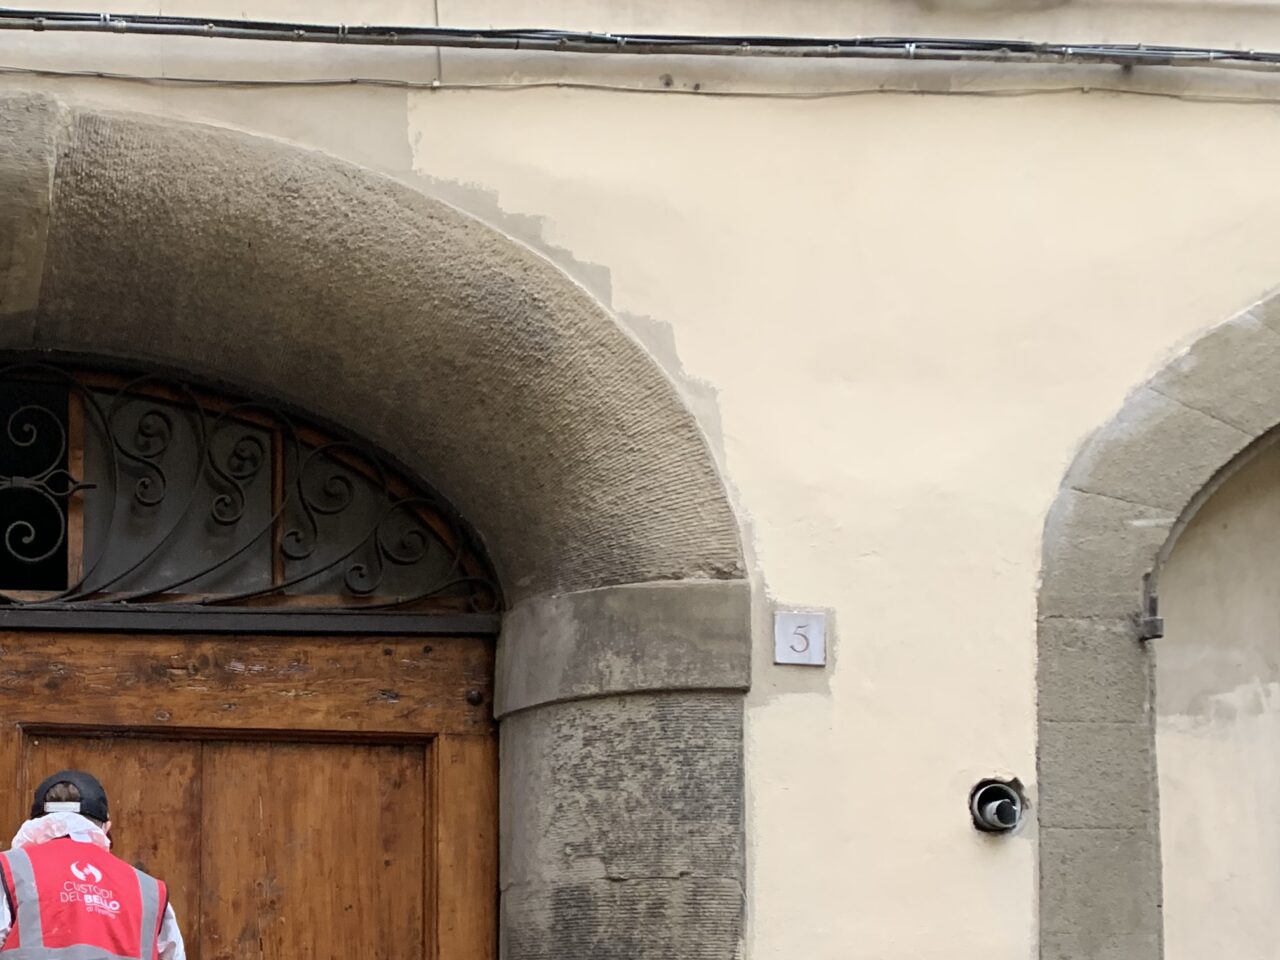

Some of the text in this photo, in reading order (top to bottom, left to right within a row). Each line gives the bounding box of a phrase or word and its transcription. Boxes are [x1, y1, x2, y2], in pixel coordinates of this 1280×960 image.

[790, 624, 810, 653] 5
[63, 880, 113, 899] CUSTODI
[60, 891, 120, 911] DEL BELLO
